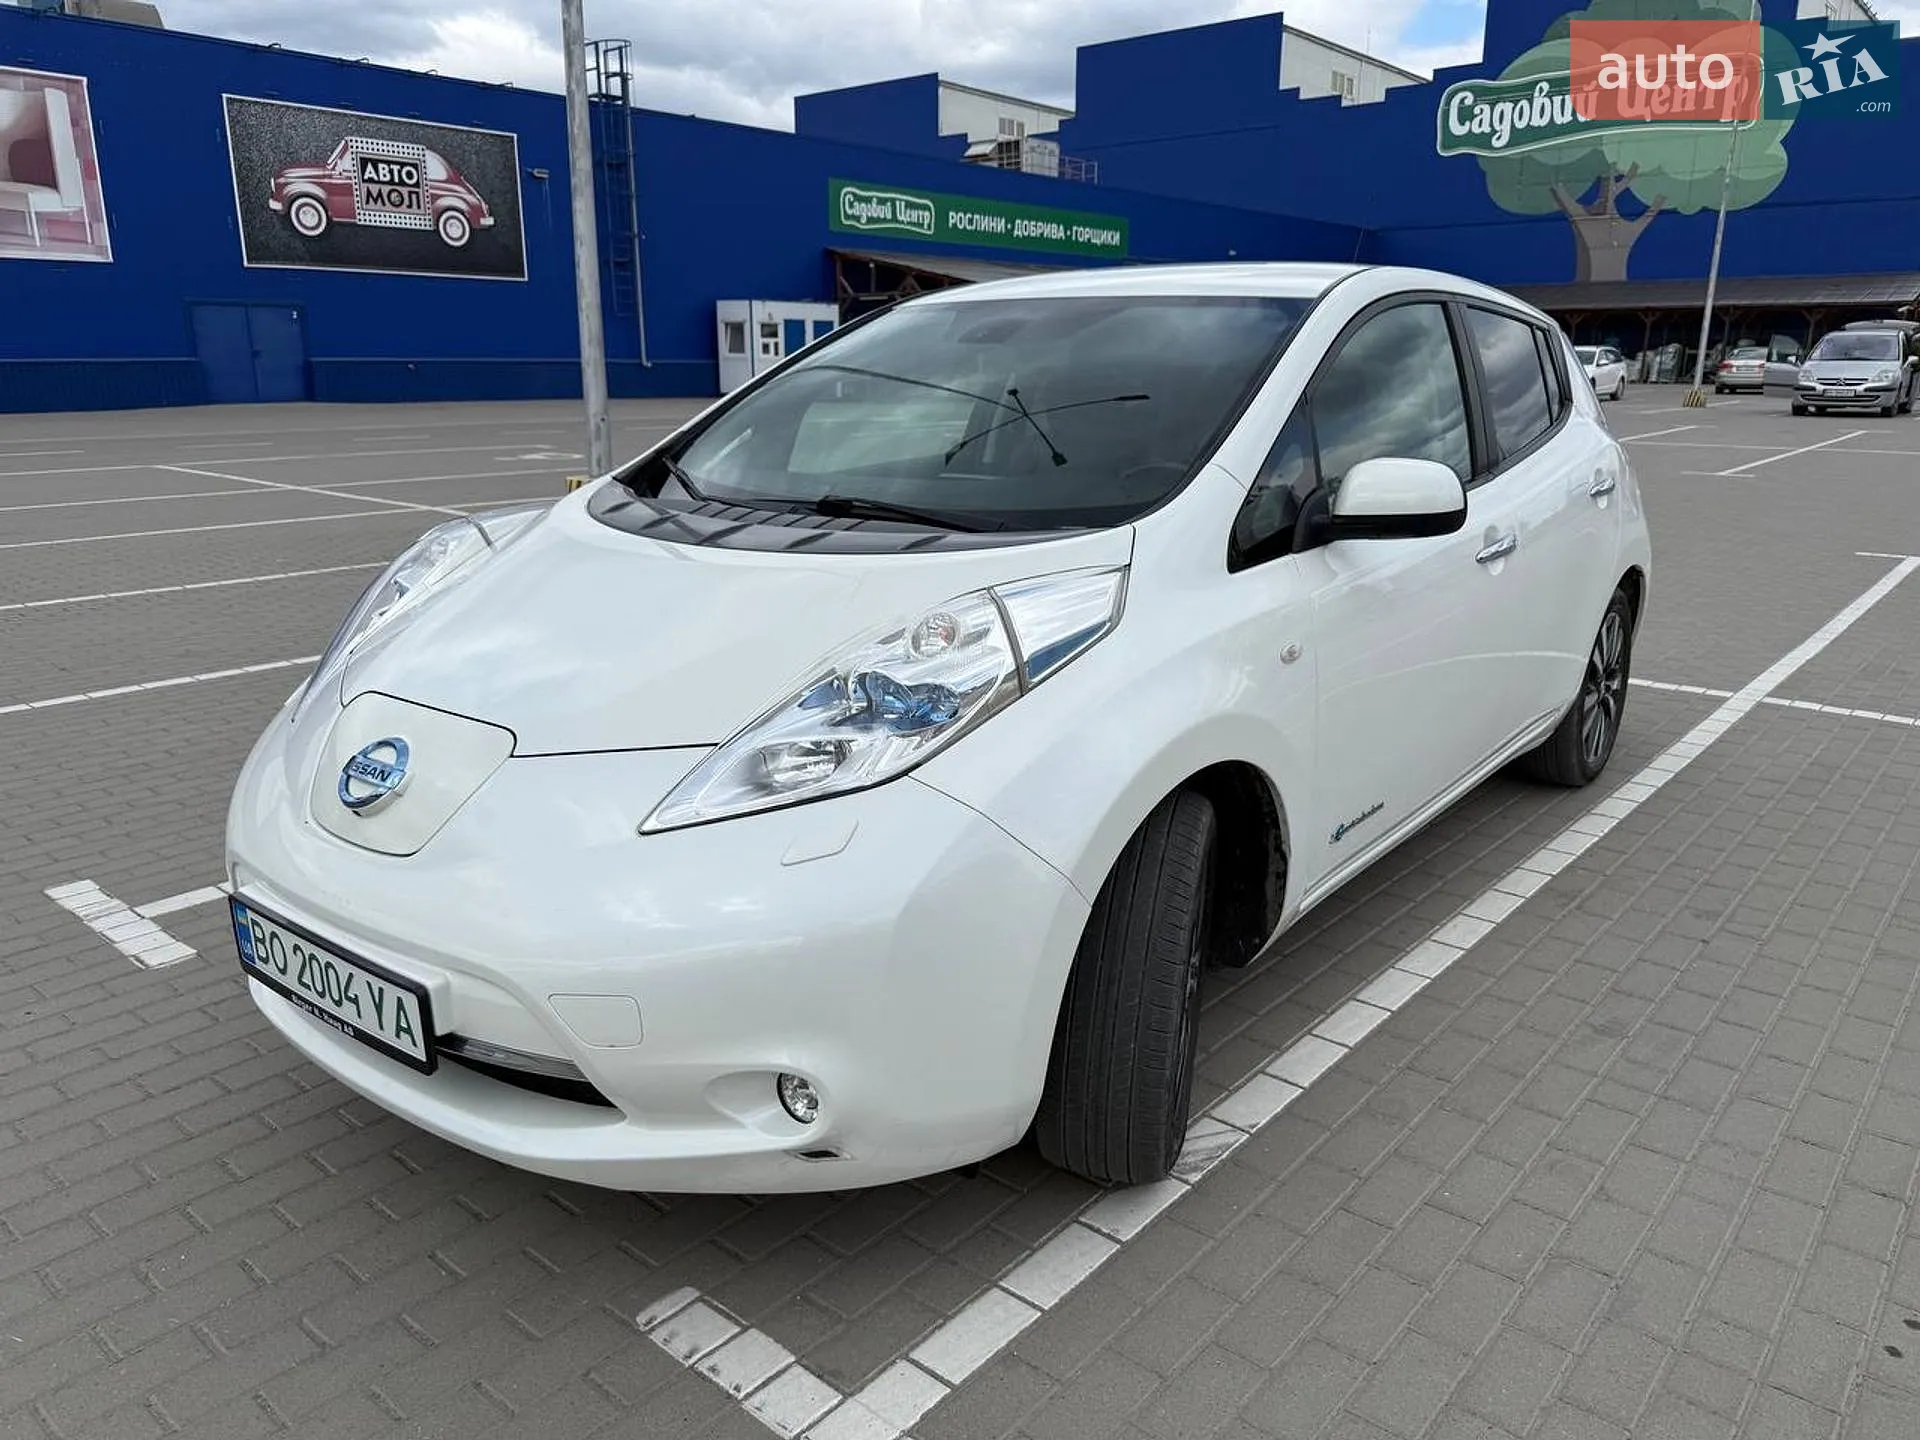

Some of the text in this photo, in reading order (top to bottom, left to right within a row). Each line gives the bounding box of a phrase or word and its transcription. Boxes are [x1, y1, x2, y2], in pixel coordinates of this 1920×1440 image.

[363, 161, 419, 186] АВТО
[365, 187, 421, 211] МОЛ
[948, 211, 1121, 247] РОСЛИНИ ДОБРИВА ГОРЩИКИ
[250, 917, 288, 977] BO
[292, 942, 362, 1020] 2004
[366, 979, 418, 1049] YA
